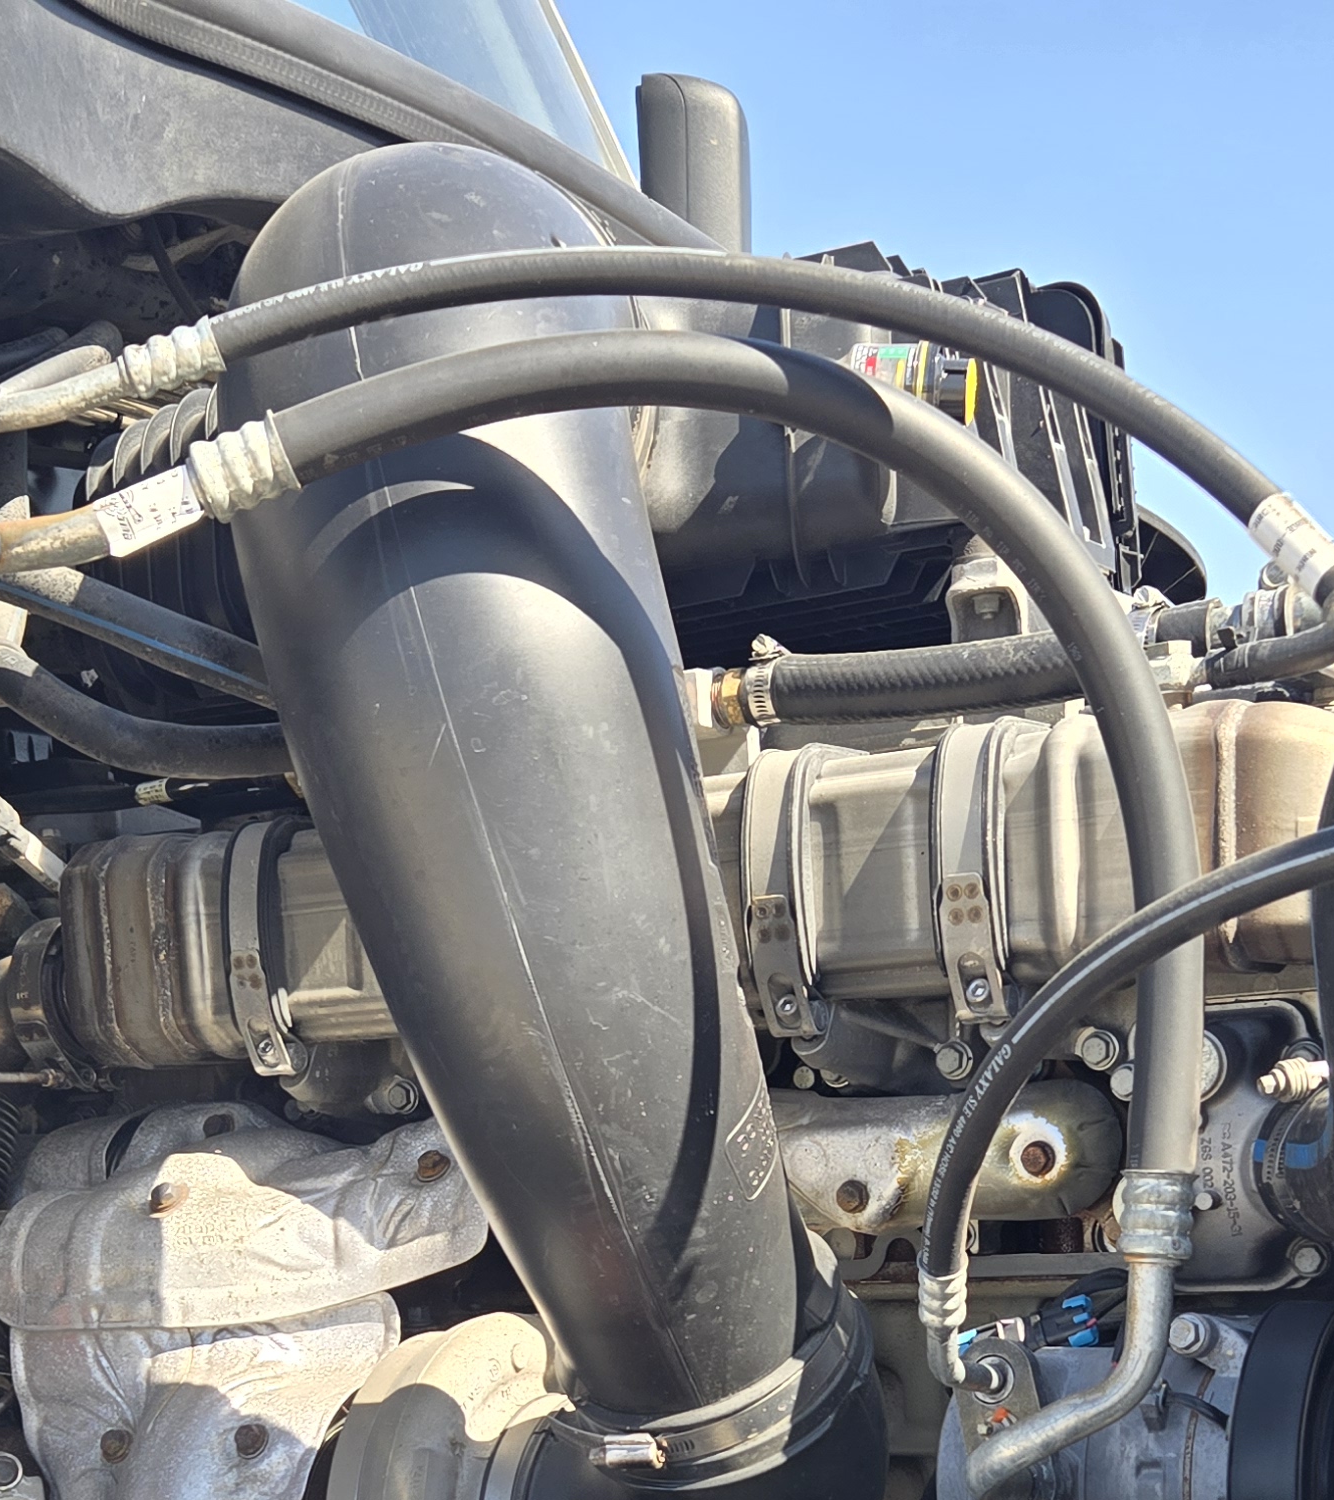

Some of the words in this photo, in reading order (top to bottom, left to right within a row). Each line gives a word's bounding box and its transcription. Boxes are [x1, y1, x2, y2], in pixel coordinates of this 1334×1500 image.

[974, 1043, 1013, 1101] GALAXY
[960, 1096, 979, 1118] SLE
[938, 1152, 952, 1180] HOSE
